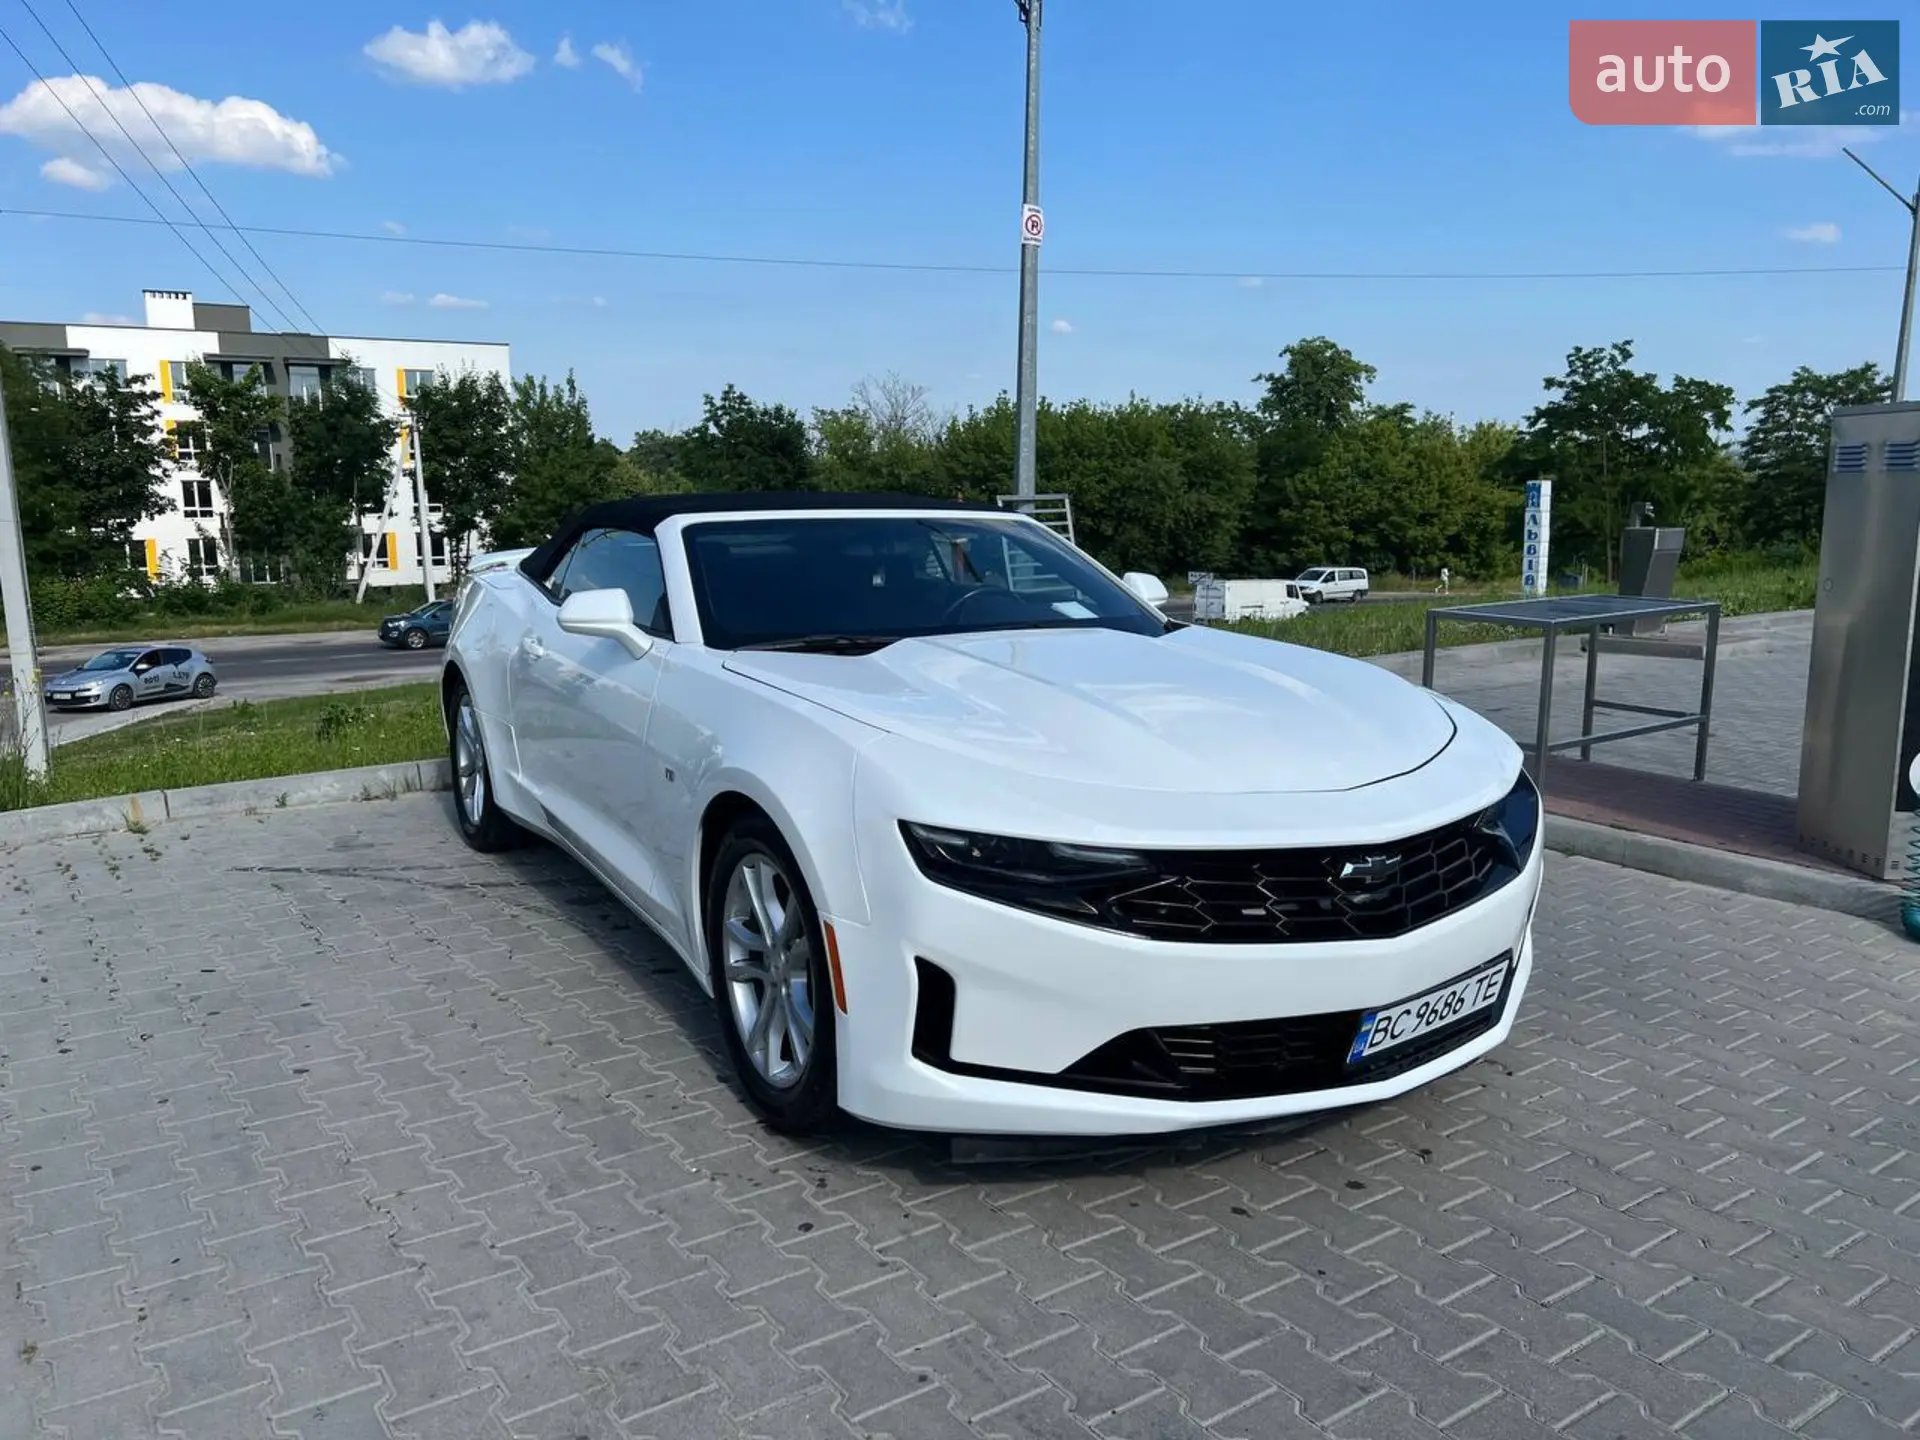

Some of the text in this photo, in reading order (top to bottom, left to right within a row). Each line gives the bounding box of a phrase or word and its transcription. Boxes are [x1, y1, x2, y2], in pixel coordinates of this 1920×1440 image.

[1368, 1009, 1411, 1048] BC
[1411, 983, 1470, 1033] 9686
[1472, 968, 1504, 1007] TE
